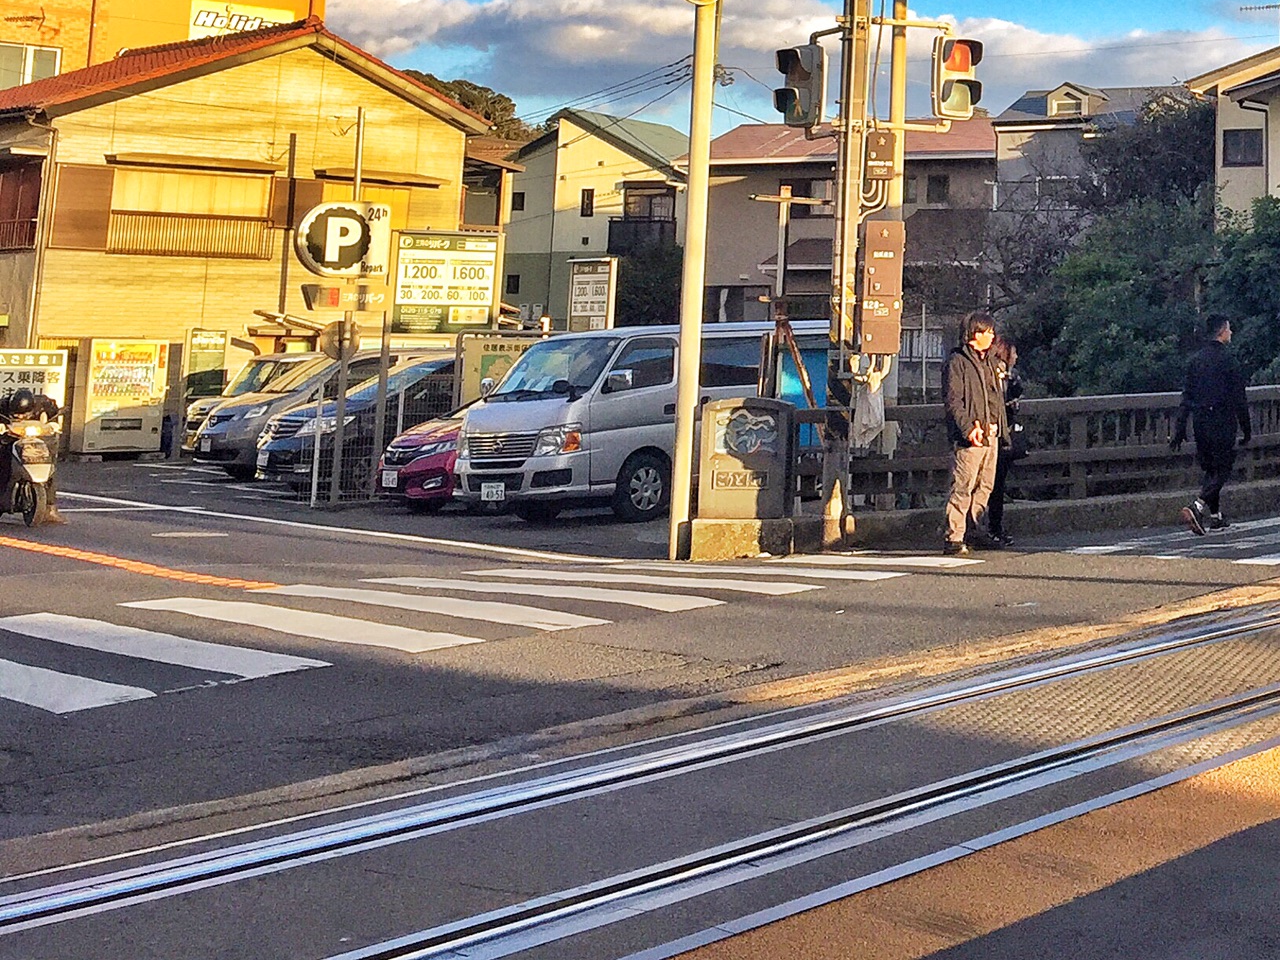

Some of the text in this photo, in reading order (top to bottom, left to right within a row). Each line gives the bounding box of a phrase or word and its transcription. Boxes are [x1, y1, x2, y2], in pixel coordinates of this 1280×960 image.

[367, 207, 388, 222] 24h
[324, 216, 363, 263] P
[360, 261, 383, 273] Repark
[0, 371, 60, 384] ス乗降客
